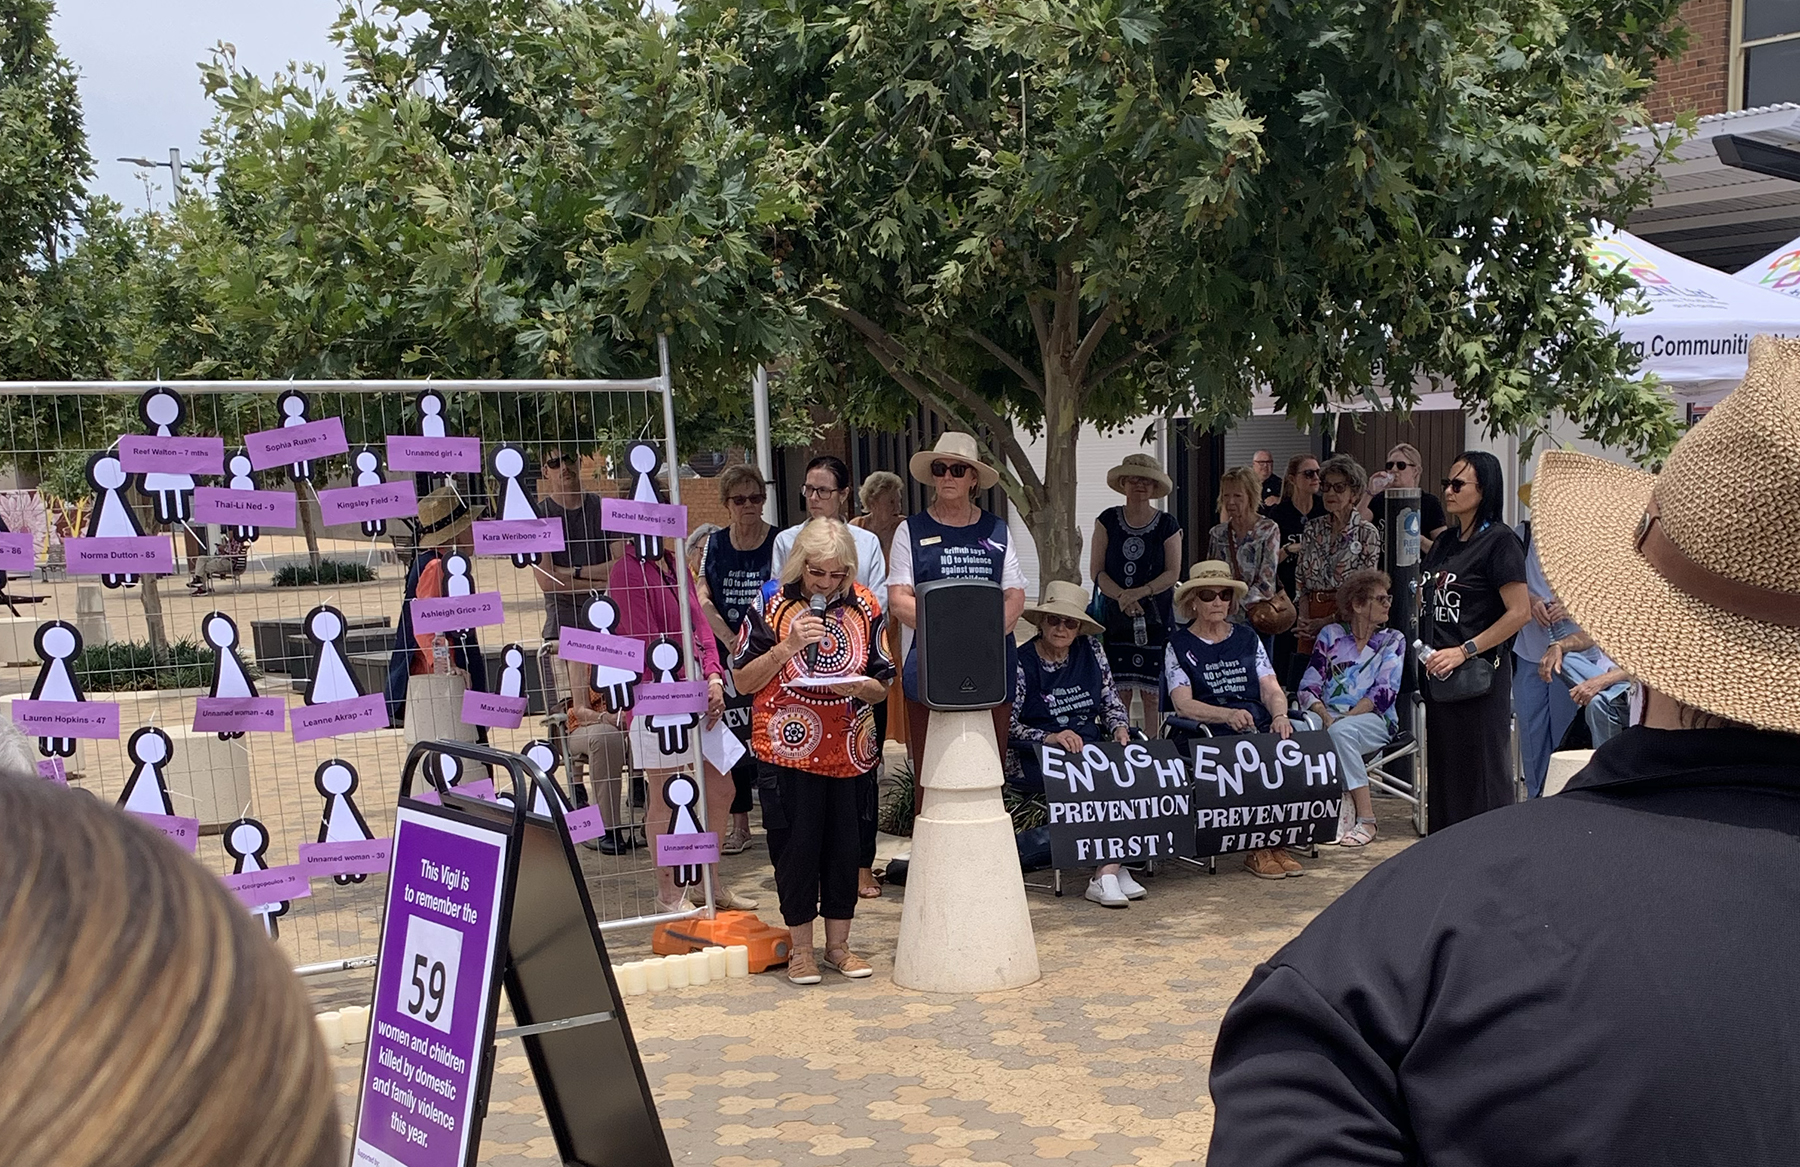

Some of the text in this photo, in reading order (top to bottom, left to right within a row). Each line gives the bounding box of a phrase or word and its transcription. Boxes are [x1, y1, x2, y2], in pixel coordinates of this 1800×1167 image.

[1651, 333, 1748, 357] Communiti
[265, 442, 292, 452] Sophia
[405, 449, 439, 457] Unnamed
[440, 450, 453, 458] girl
[337, 500, 369, 509] Kingsley
[370, 496, 389, 505] Field
[611, 511, 636, 520] Rachel
[542, 531, 552, 539] 27
[11, 547, 22, 555] 86
[80, 551, 108, 560] Norma
[111, 551, 138, 559] Dutton
[145, 551, 156, 559] 85
[944, 546, 986, 556] Griffith says
[940, 555, 992, 565] NO to violence
[941, 565, 993, 576] against women
[421, 609, 455, 619] Ashleigh
[456, 606, 477, 615] Grice
[482, 604, 491, 612] 23
[567, 640, 595, 650] Amanda
[596, 645, 623, 656] Rahman
[1225, 660, 1240, 668] says
[1203, 671, 1215, 681] NO
[1063, 691, 1091, 704] violence
[265, 709, 274, 717] 48
[480, 704, 495, 712] Max
[1050, 698, 1094, 717] against women
[23, 714, 53, 722] Lauren
[54, 715, 89, 724] Hopkins
[303, 717, 333, 728] Leanne
[334, 712, 358, 722] Akrap
[363, 708, 373, 717] 47
[1041, 744, 1189, 794] ENOUGH!
[1194, 739, 1338, 798] ENOUGH!
[1049, 795, 1190, 824] PREVENTION
[1197, 798, 1342, 829] PREVENTION
[583, 820, 592, 828] 39
[176, 829, 186, 837] 18
[664, 844, 693, 852] Unnamed
[307, 855, 343, 863] Unnamed
[344, 853, 370, 861] woman
[376, 852, 385, 860] 30
[421, 858, 470, 892] This Vigil is
[404, 883, 478, 925] to remember the
[407, 953, 446, 1023] 59
[378, 1020, 465, 1074] women and children
[378, 1045, 457, 1101] killed by domestic
[372, 1076, 455, 1132] and family violence
[390, 1111, 428, 1148] this year.
